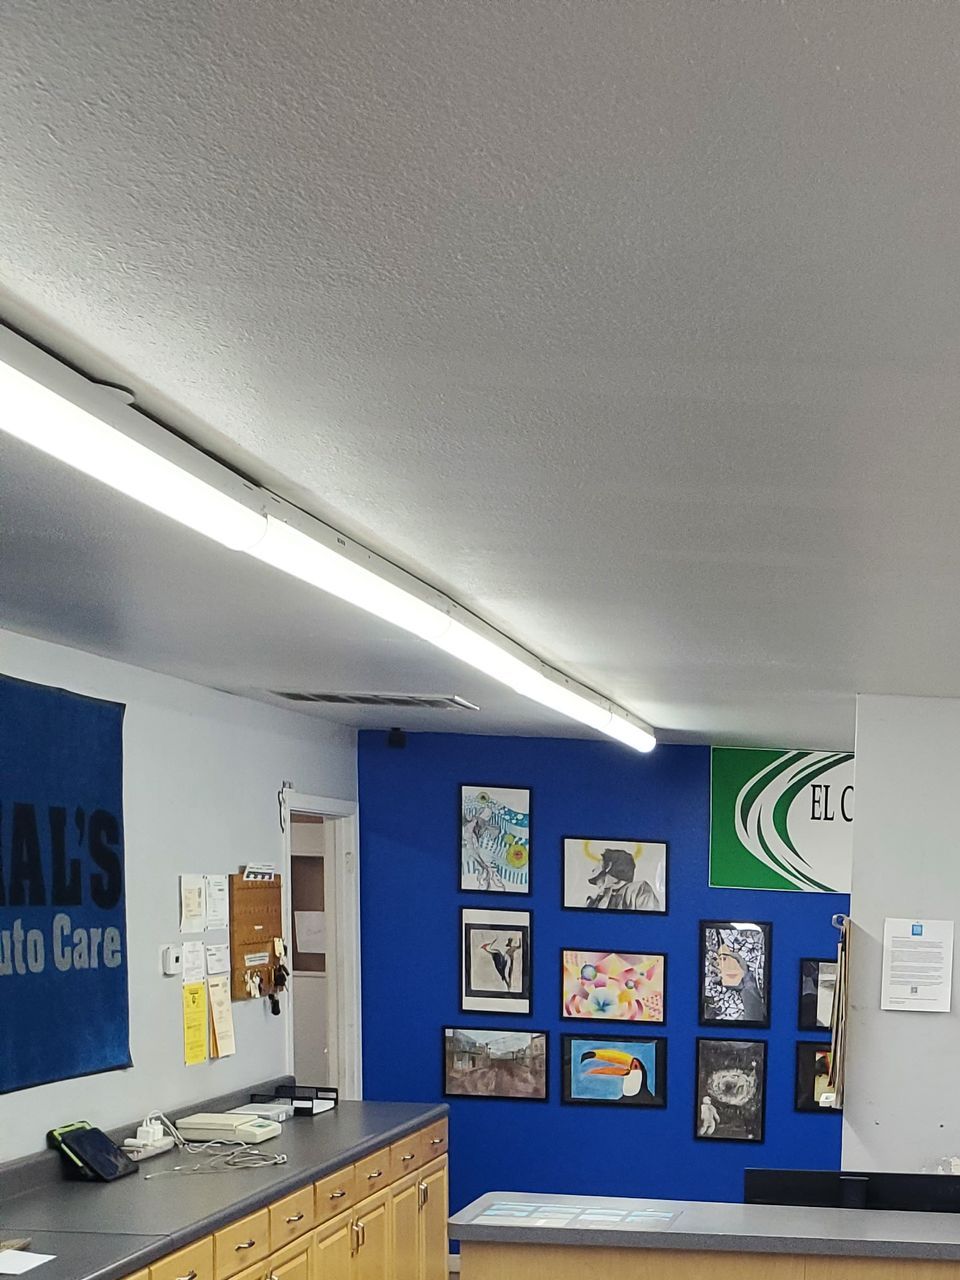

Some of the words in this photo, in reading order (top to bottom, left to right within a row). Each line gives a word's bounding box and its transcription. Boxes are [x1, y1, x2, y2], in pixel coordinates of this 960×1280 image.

[810, 784, 834, 821] EL
[0, 802, 123, 910] AL'S
[53, 912, 121, 972] Care
